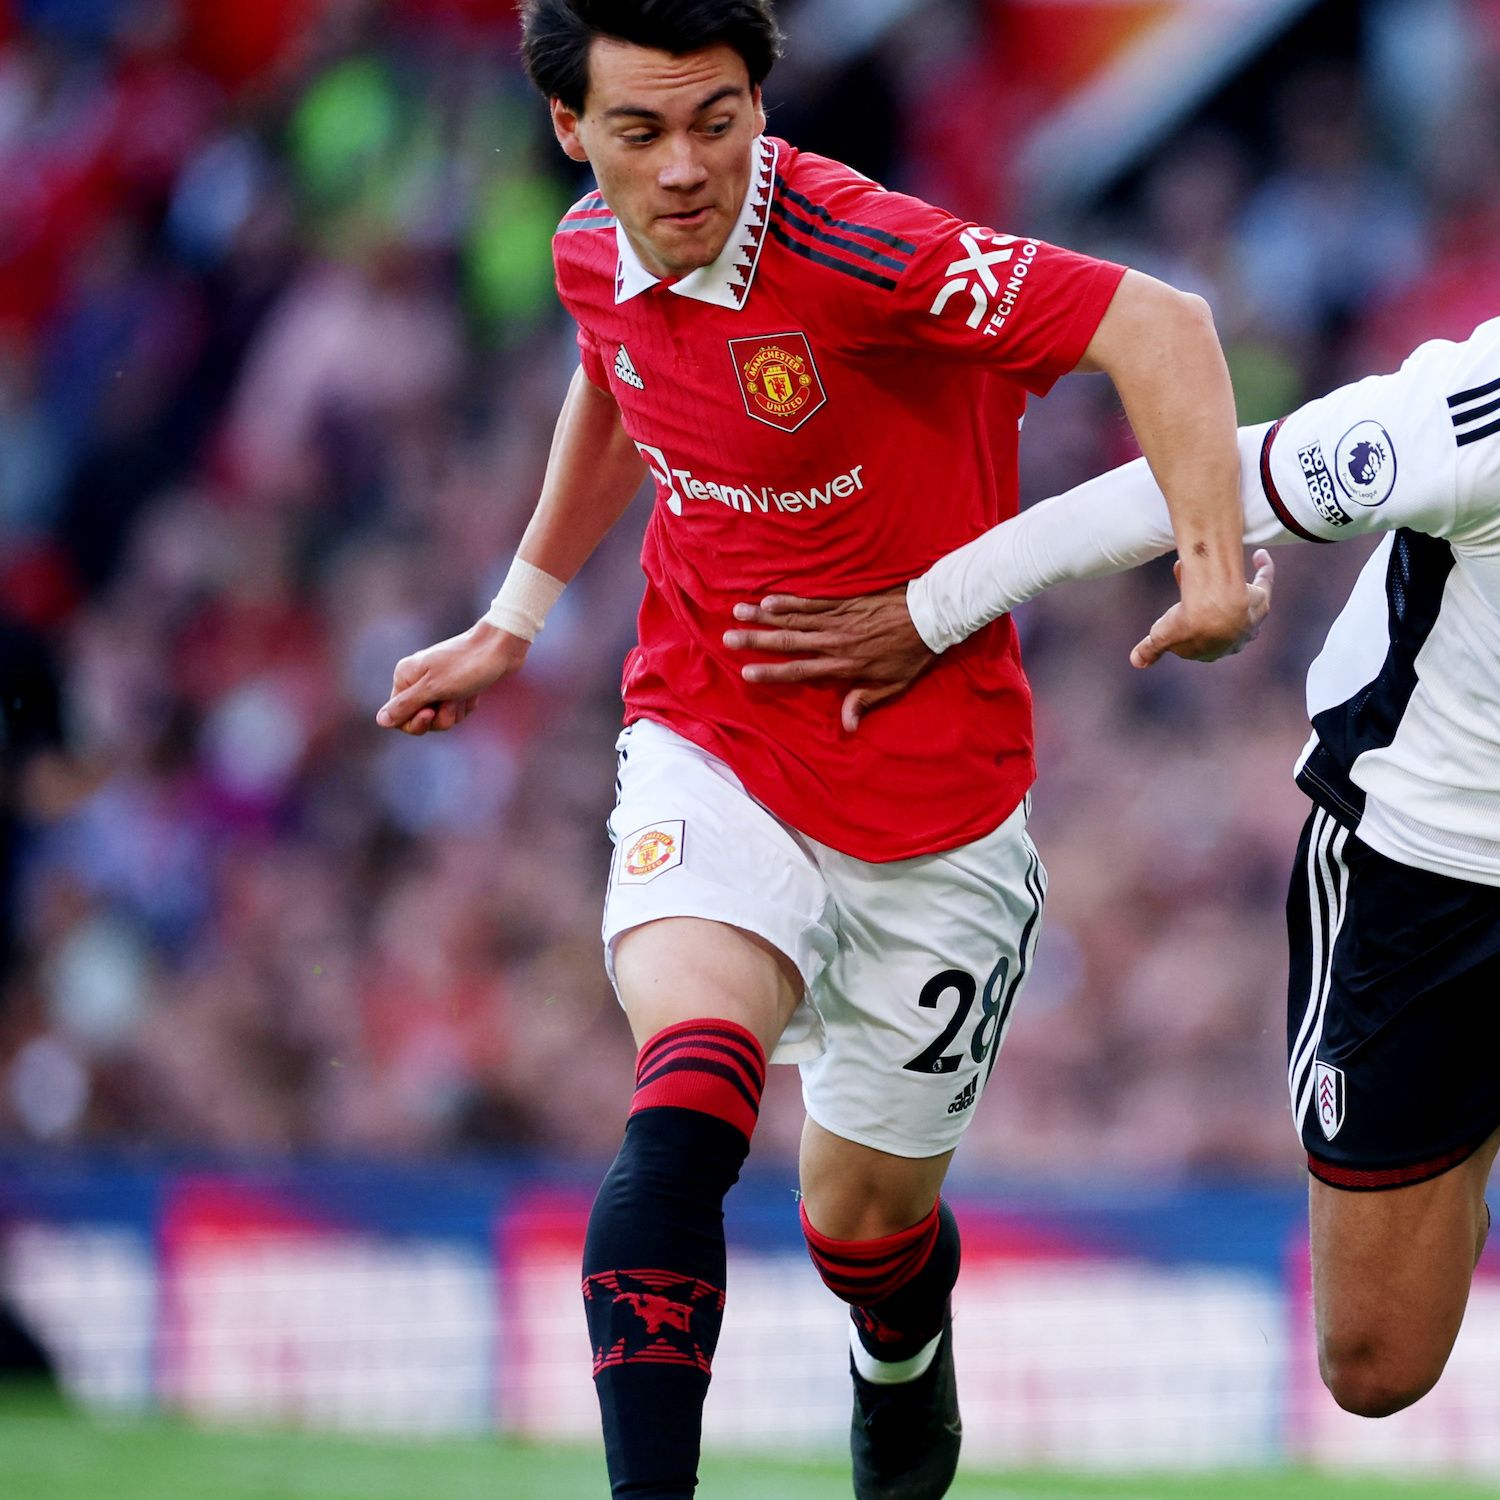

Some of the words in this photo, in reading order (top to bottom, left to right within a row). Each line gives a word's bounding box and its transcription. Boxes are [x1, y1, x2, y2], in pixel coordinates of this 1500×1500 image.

[614, 364, 645, 390] adidas
[749, 350, 801, 376] MANCHESTER
[766, 397, 803, 412] UNITED
[672, 464, 863, 513] TeamViewer
[1318, 470, 1344, 520] room
[902, 956, 1009, 1074] 28
